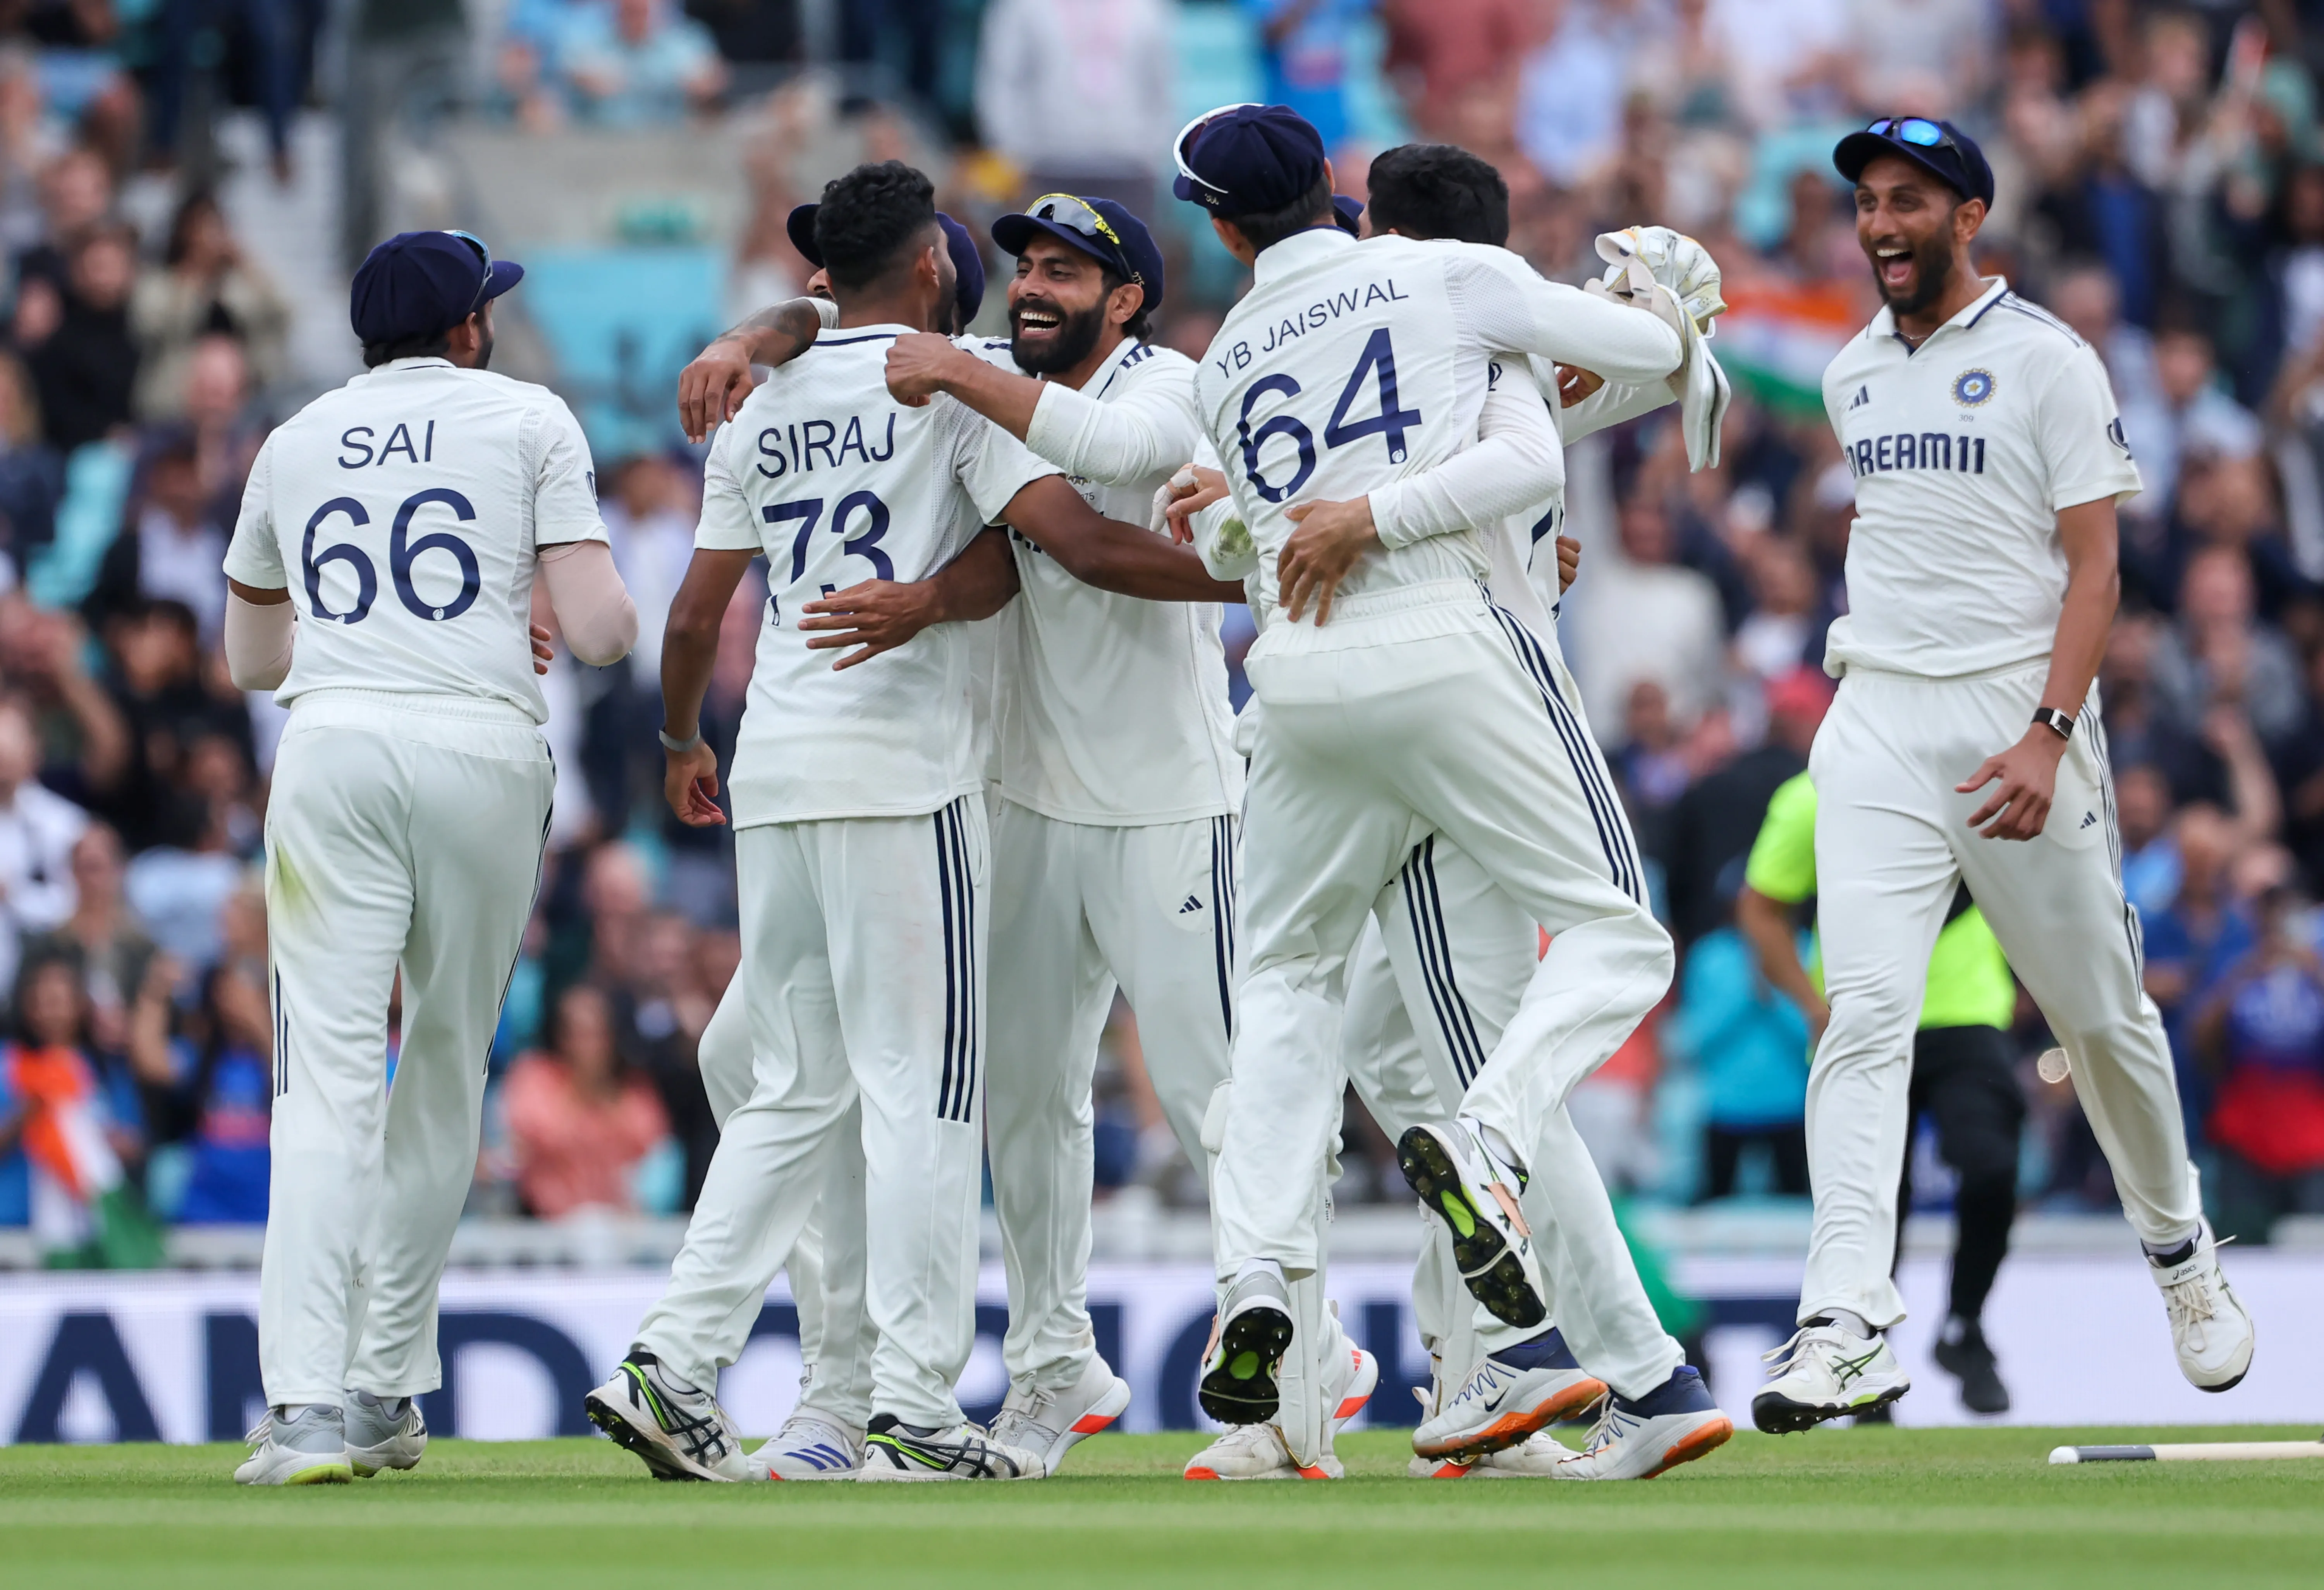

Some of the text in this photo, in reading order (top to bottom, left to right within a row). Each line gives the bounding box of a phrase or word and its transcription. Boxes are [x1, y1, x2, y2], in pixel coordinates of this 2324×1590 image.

[1217, 279, 1409, 379] YB JAISWAL
[338, 420, 435, 469] SAI
[756, 412, 896, 479] SIRAJ
[1236, 327, 1422, 503] 64
[1845, 433, 1985, 479] DREAM11
[1958, 414, 1974, 422] 309
[301, 488, 481, 625] 66
[761, 490, 894, 626] 73
